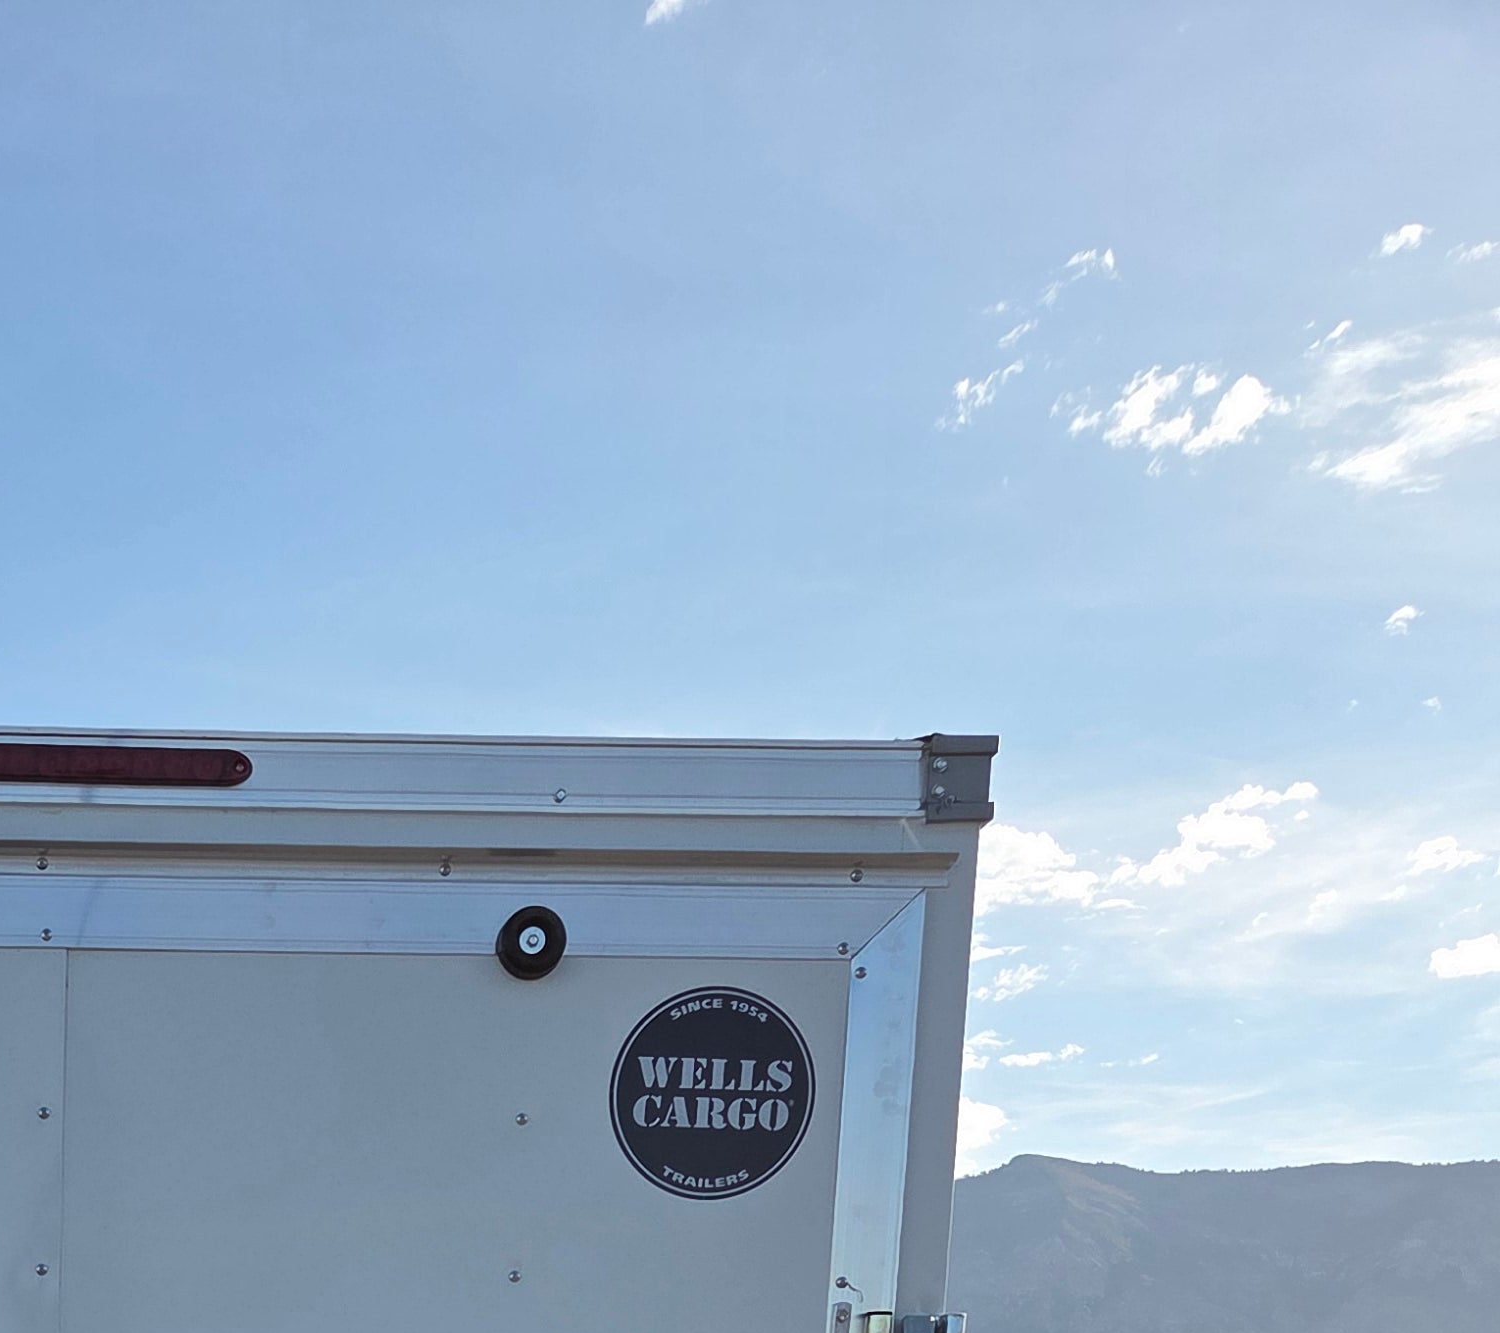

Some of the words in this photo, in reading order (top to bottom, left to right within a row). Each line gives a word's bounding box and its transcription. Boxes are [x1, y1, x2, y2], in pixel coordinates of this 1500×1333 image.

[670, 998, 723, 1020] SINCE
[731, 1000, 769, 1023] 1954
[638, 1056, 793, 1092] WELLS
[632, 1094, 790, 1131] CARGO
[662, 1165, 750, 1188] TRAILERS
